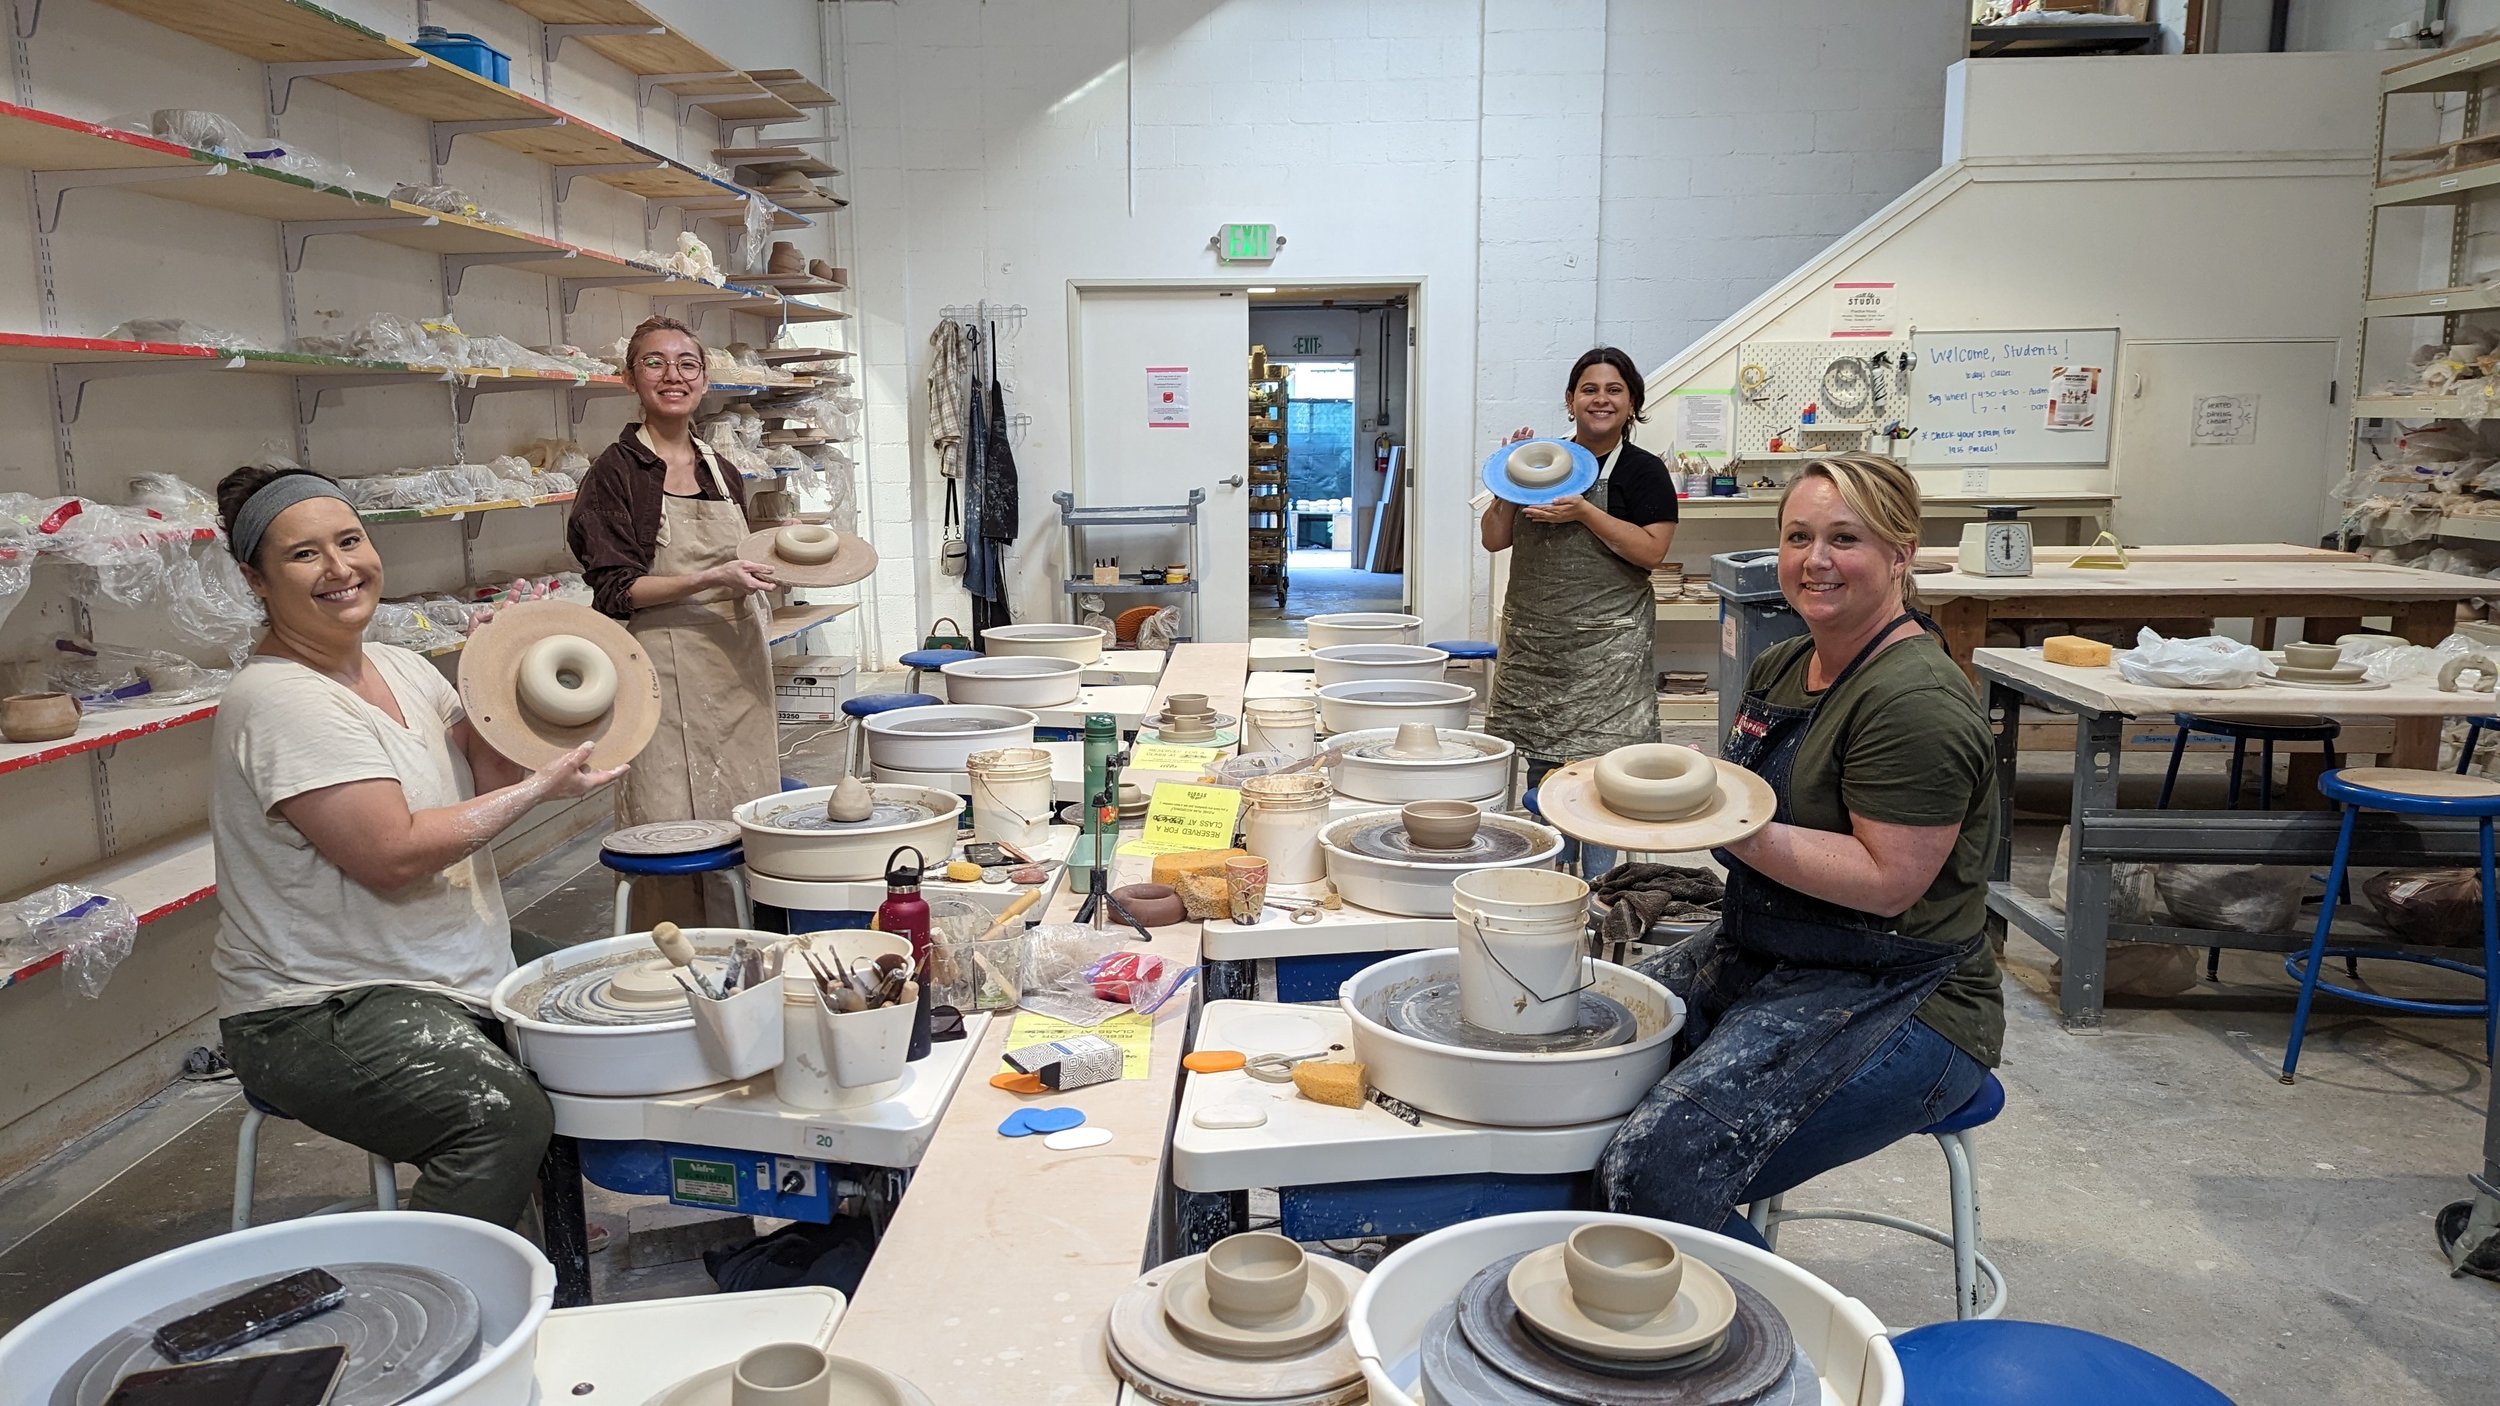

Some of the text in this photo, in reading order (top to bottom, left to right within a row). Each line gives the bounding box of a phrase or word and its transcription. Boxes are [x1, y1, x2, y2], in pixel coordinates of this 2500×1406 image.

[1230, 224, 1270, 256] EXIT
[1298, 338, 1318, 354] EXIT
[1164, 826, 1179, 834] FOR
[1200, 820, 1223, 828] CLASS
[1182, 828, 1221, 838] RESERVED
[816, 1134, 832, 1148] 20
